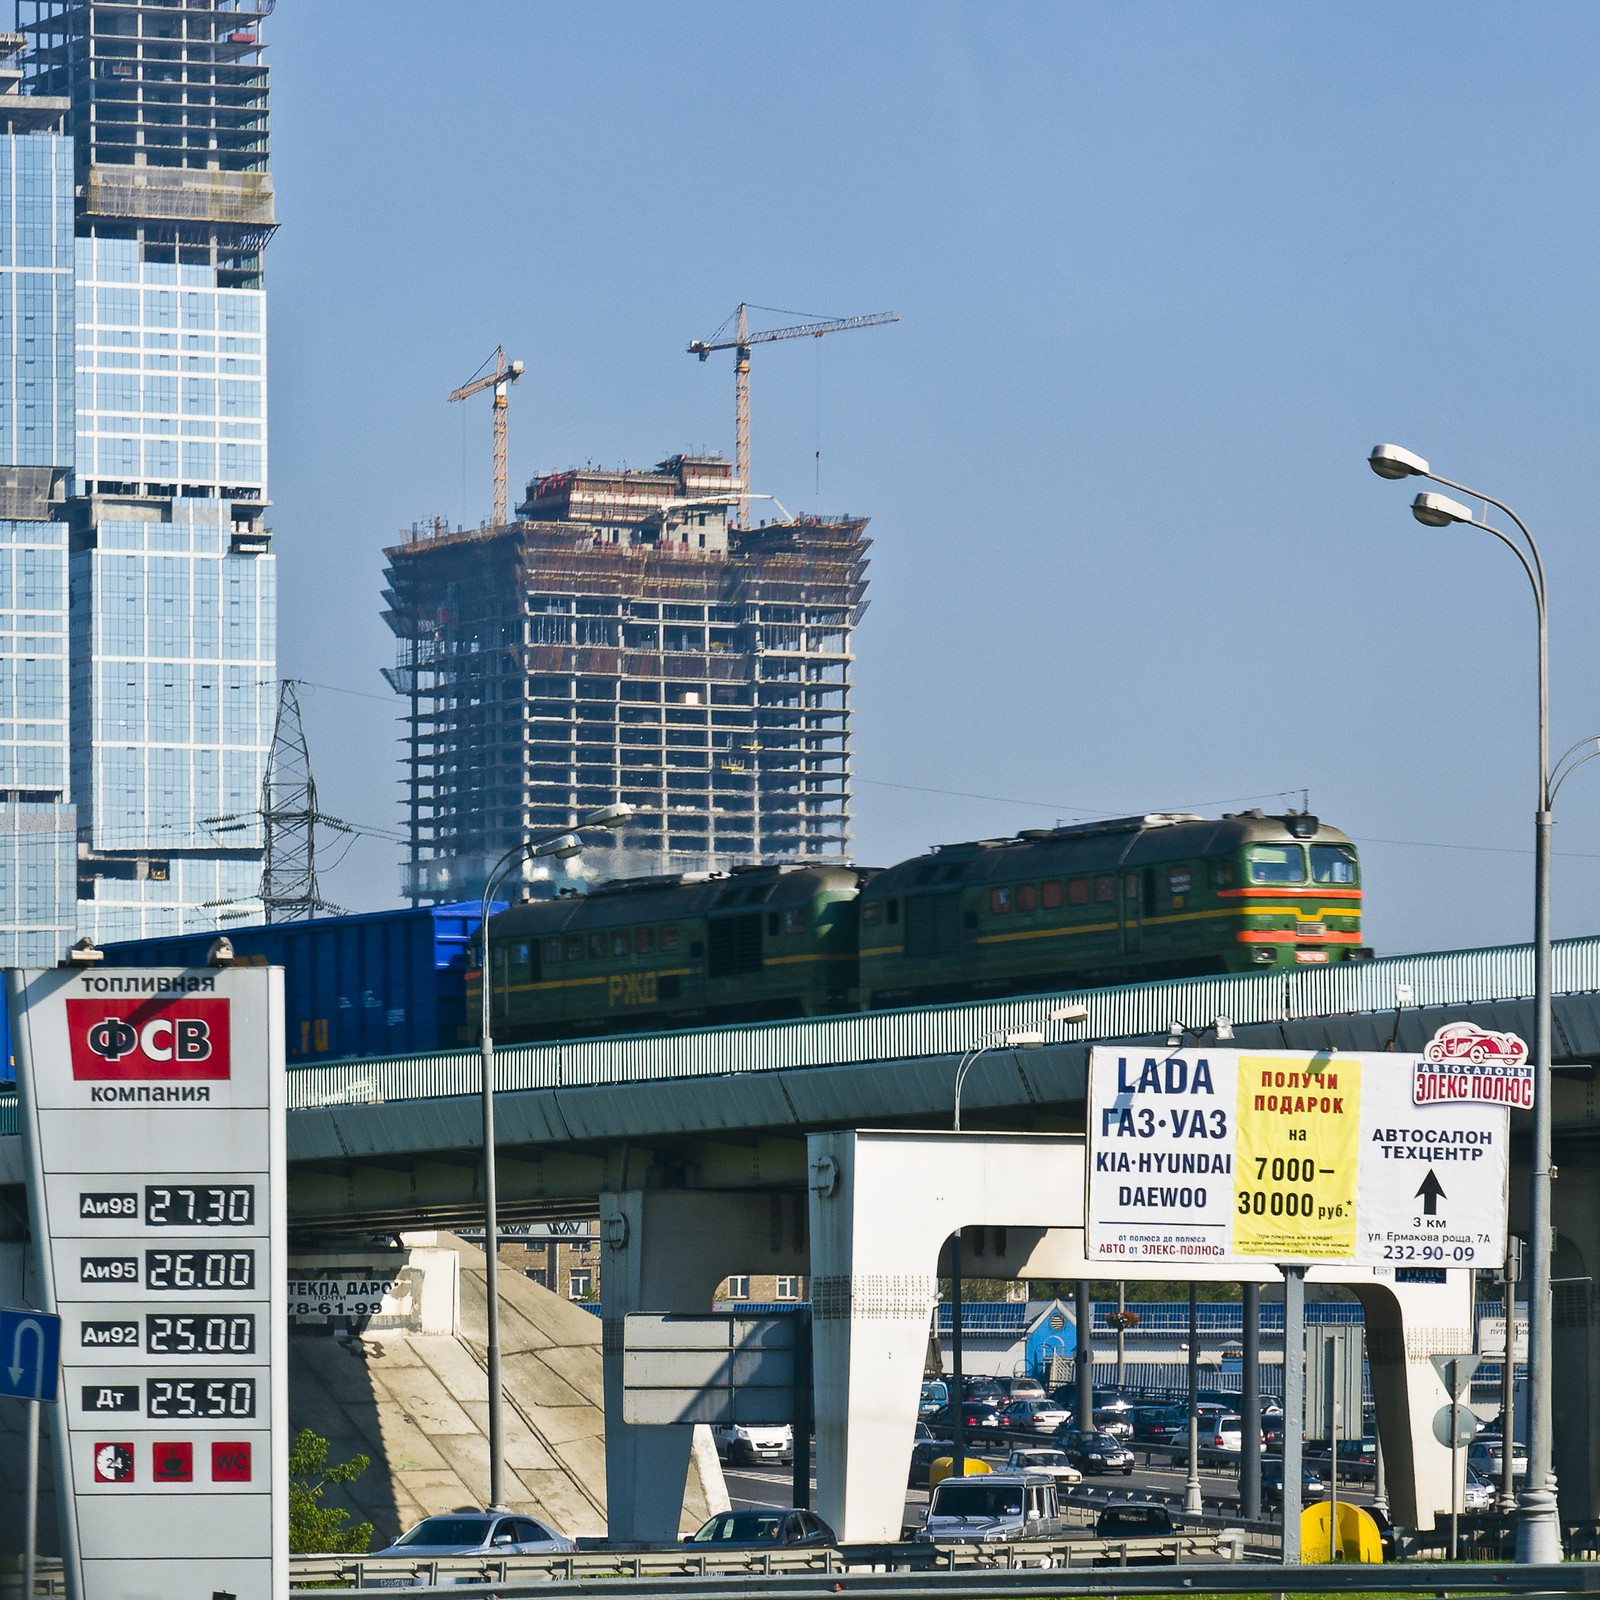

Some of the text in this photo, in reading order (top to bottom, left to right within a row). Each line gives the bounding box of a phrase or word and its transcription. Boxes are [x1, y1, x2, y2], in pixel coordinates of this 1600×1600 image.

[81, 976, 215, 992] топливная
[87, 1017, 212, 1061] ФСВ
[1118, 1057, 1214, 1094] LADA
[1422, 1063, 1527, 1077] АВТОСАЛОНЫ
[1261, 1071, 1338, 1090] ПОЛУЧИ
[91, 1086, 210, 1102] компания
[1416, 1074, 1531, 1106] ЭЛЕКС ПОЛЮС
[1254, 1095, 1344, 1115] ПОДАРОК
[1289, 1129, 1307, 1141] на
[1372, 1128, 1492, 1145] АВТОСАЛОН
[1381, 1145, 1483, 1162] ТЕХЦЕНТР
[1119, 1186, 1207, 1208] DAEWOO
[81, 1190, 250, 1223] Аи98 27.30
[1413, 1217, 1447, 1228] 3 км
[1118, 1234, 1127, 1242] от
[1129, 1235, 1161, 1243] полюса
[1163, 1236, 1173, 1244] до
[1368, 1231, 1491, 1244] ул. Ермакова роща, 7А
[1099, 1243, 1126, 1254] АВТО
[1128, 1246, 1138, 1254] от
[1383, 1245, 1475, 1261] 232-90-09
[82, 1254, 250, 1288] Аи95 26.00
[346, 1282, 399, 1295] ДАРО
[83, 1319, 251, 1352] Аи92 25.00
[96, 1383, 251, 1416] Дт 25.50
[106, 1457, 123, 1470] 24
[215, 1453, 248, 1471] WC
